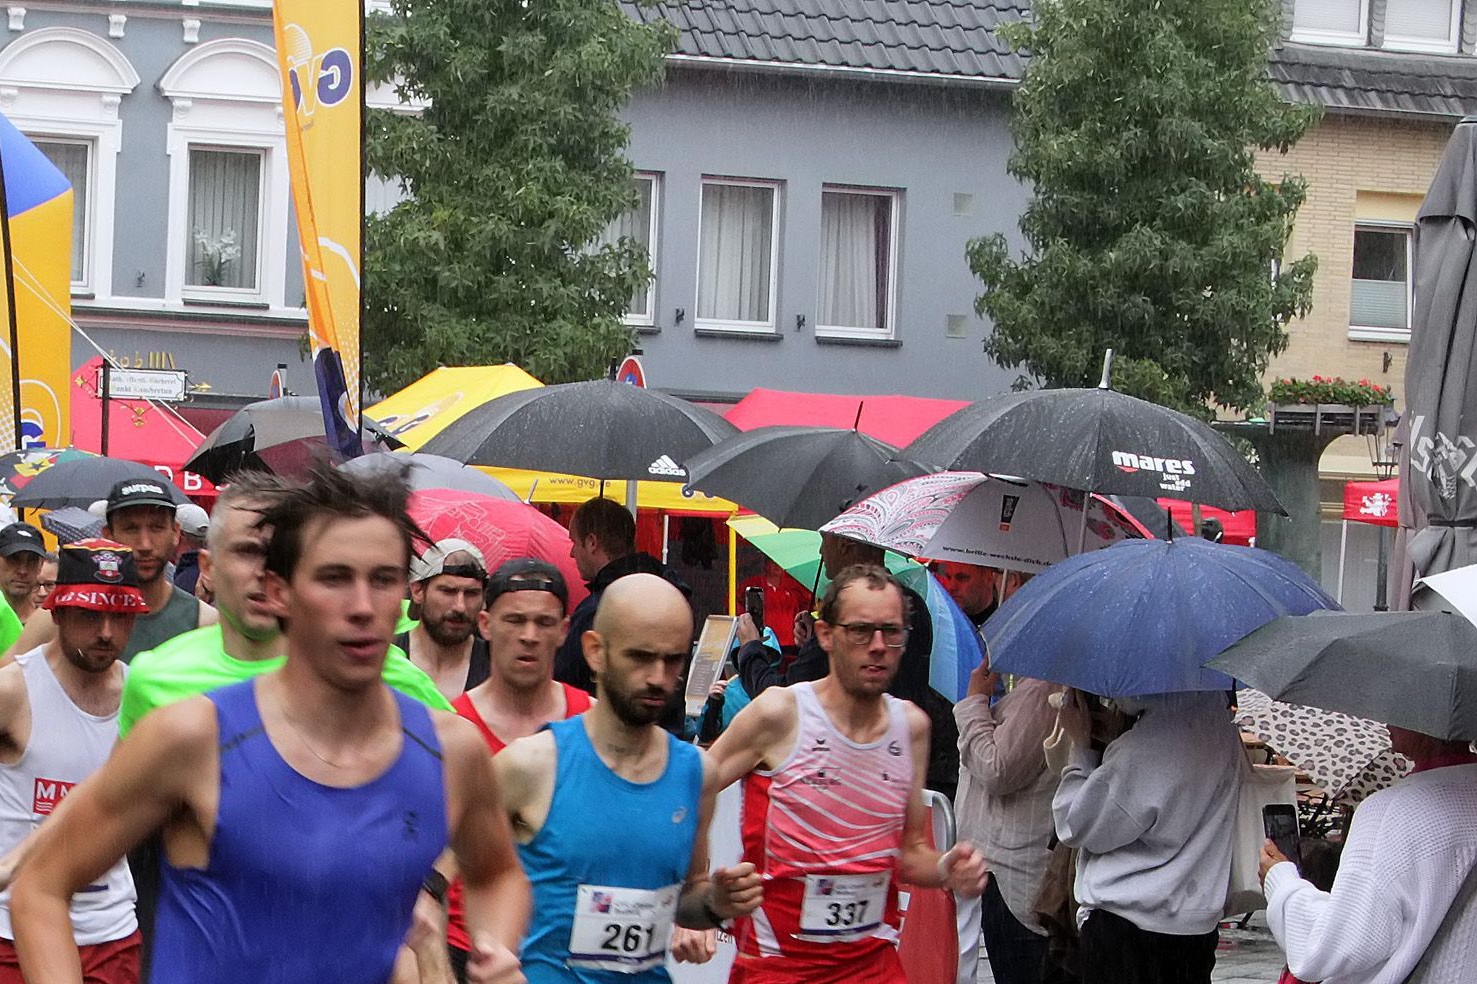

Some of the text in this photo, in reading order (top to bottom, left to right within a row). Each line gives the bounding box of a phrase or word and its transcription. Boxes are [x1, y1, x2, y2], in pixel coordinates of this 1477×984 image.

[1112, 451, 1196, 475] mares
[648, 466, 687, 477] adidas
[1162, 473, 1180, 481] just
[549, 477, 612, 489] www.gvg.e
[1159, 483, 1185, 492] water
[826, 899, 868, 926] 337
[601, 923, 656, 952] 261
